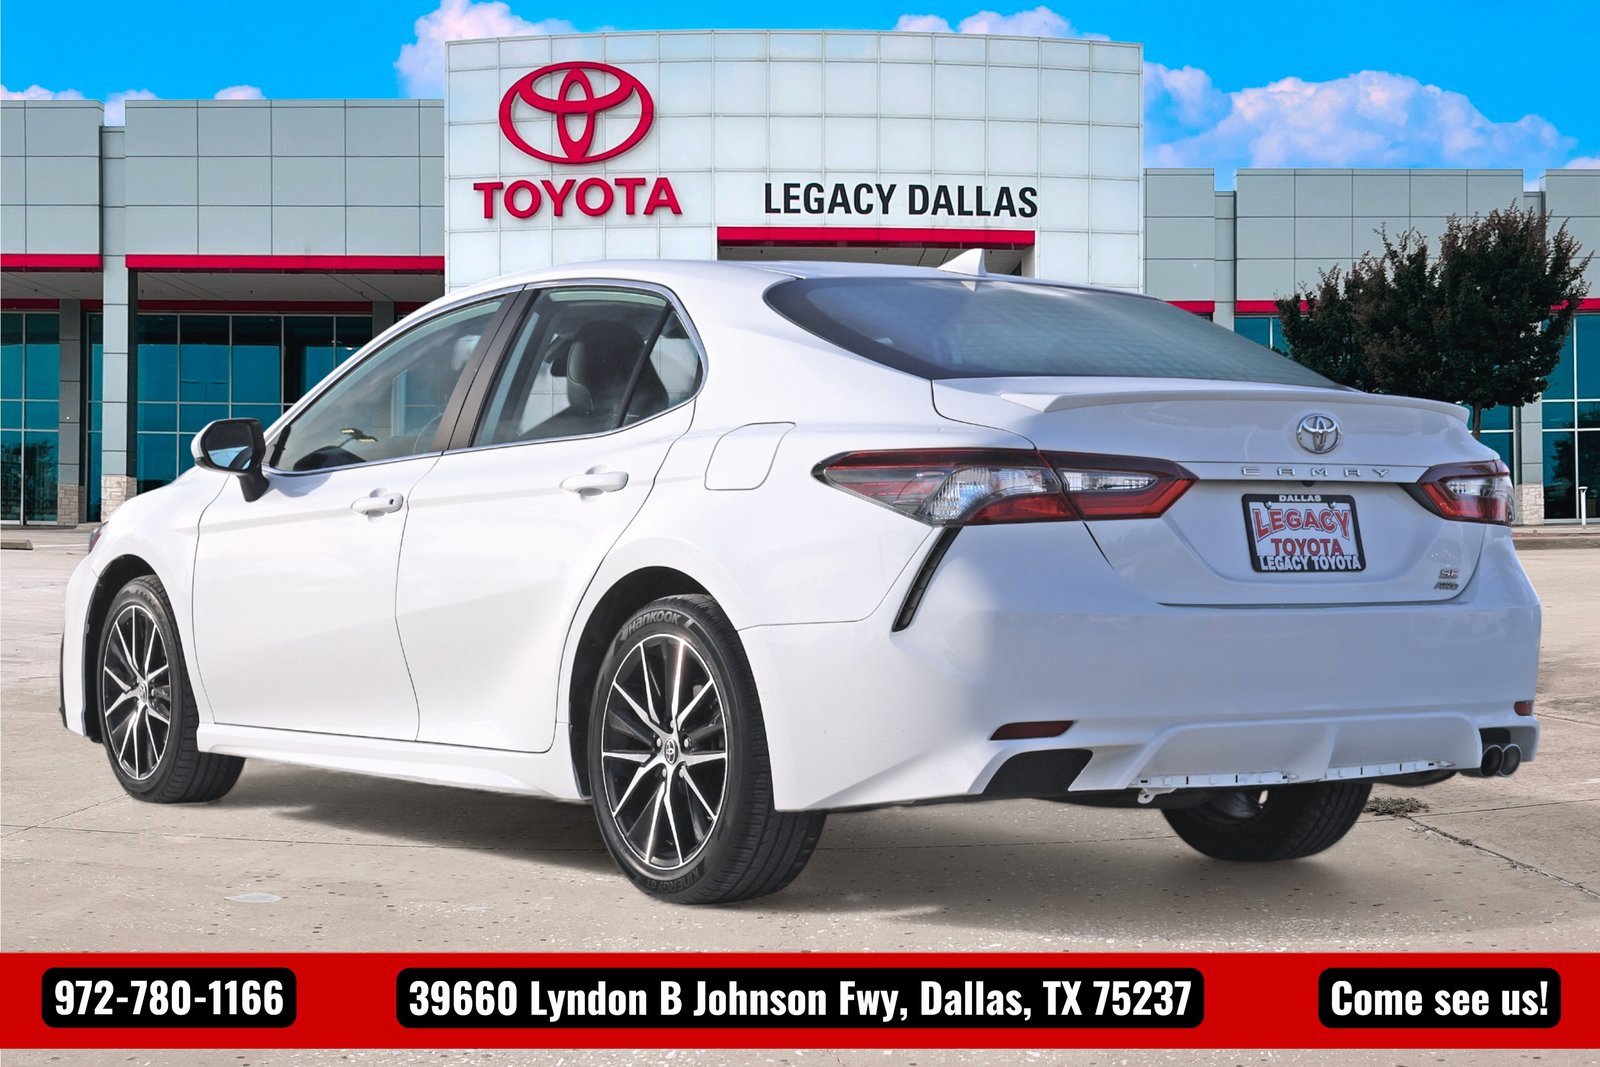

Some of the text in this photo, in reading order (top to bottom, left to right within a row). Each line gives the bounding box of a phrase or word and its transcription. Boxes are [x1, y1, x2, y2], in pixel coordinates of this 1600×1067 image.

[474, 177, 682, 219] TOYOTA
[765, 183, 1038, 218] LEGACY DALLAS
[1241, 466, 1389, 478] CAMRY
[1278, 494, 1322, 503] DALLAS
[1253, 508, 1350, 541] LEGACY
[1271, 538, 1344, 557] TOYOTA
[1259, 555, 1362, 571] LEGACY TOYOTA
